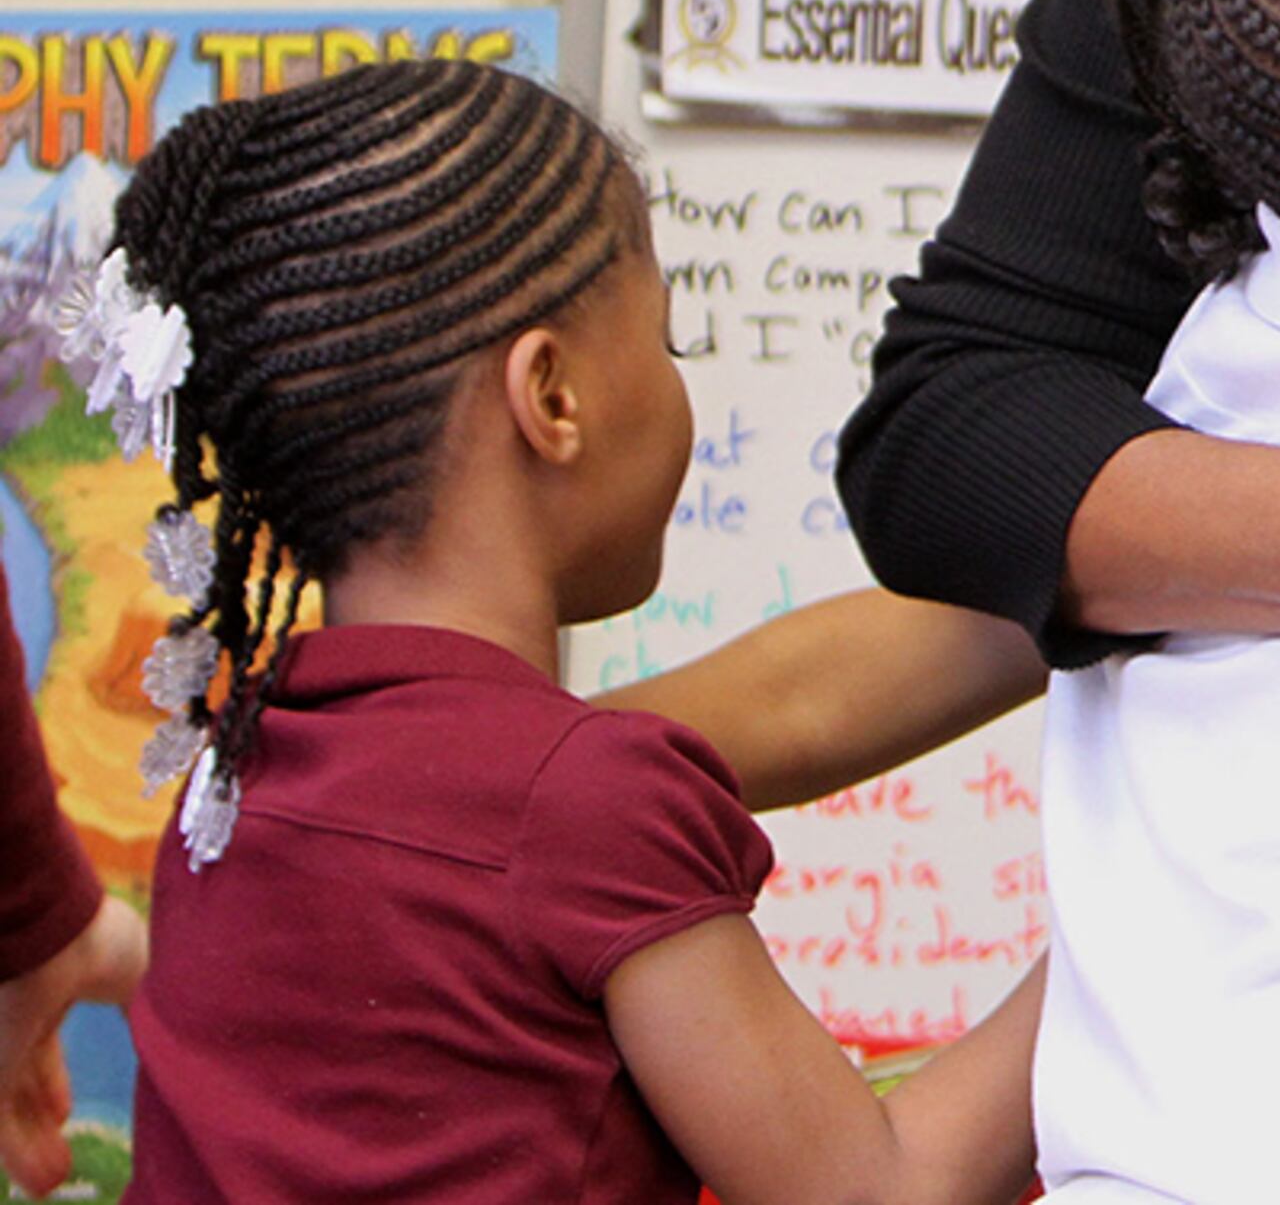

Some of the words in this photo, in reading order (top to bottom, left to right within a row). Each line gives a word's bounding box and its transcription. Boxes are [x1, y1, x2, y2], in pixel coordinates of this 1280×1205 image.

[882, 185, 944, 237] I
[664, 259, 734, 295] wn
[695, 405, 760, 469] at
[962, 749, 1040, 825] th
[764, 843, 942, 937] eorgia
